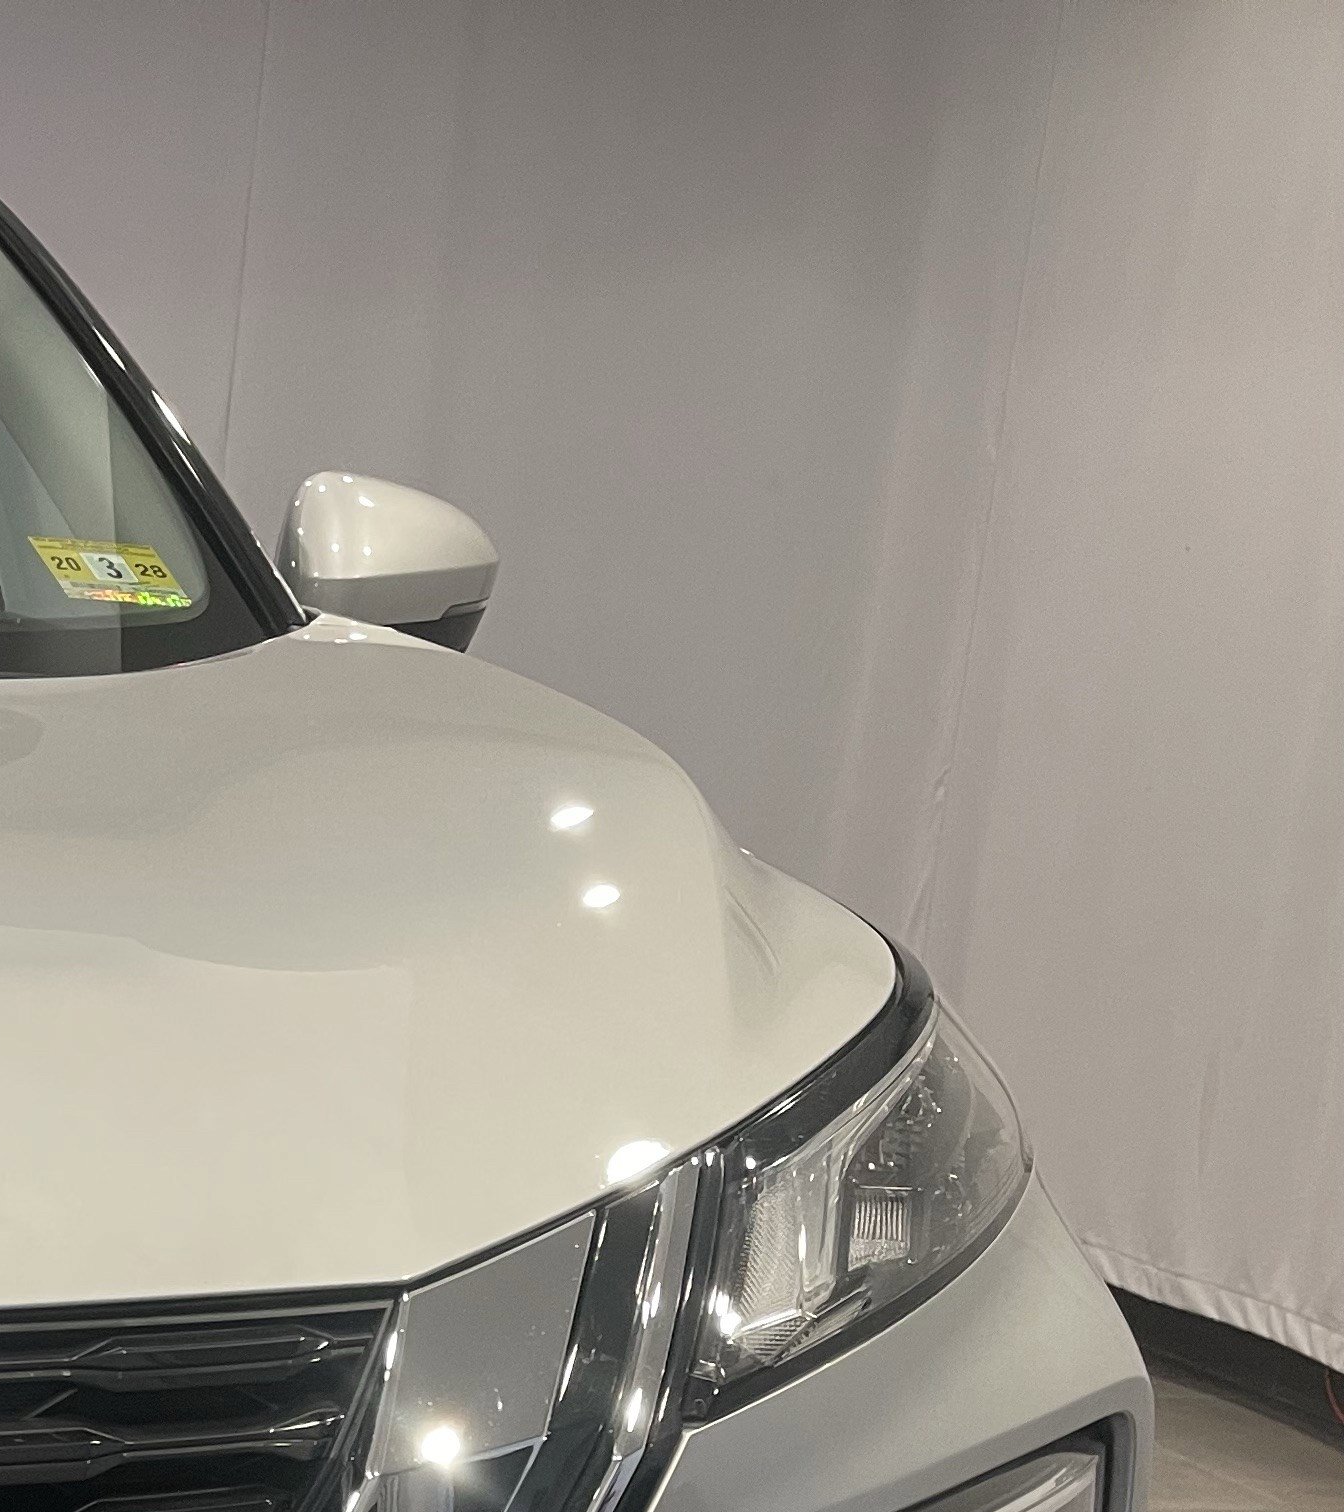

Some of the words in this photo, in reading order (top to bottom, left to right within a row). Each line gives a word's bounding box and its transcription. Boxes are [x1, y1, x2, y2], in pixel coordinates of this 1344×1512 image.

[51, 555, 81, 572] 20
[98, 557, 123, 580] 3
[134, 563, 167, 579] 28
